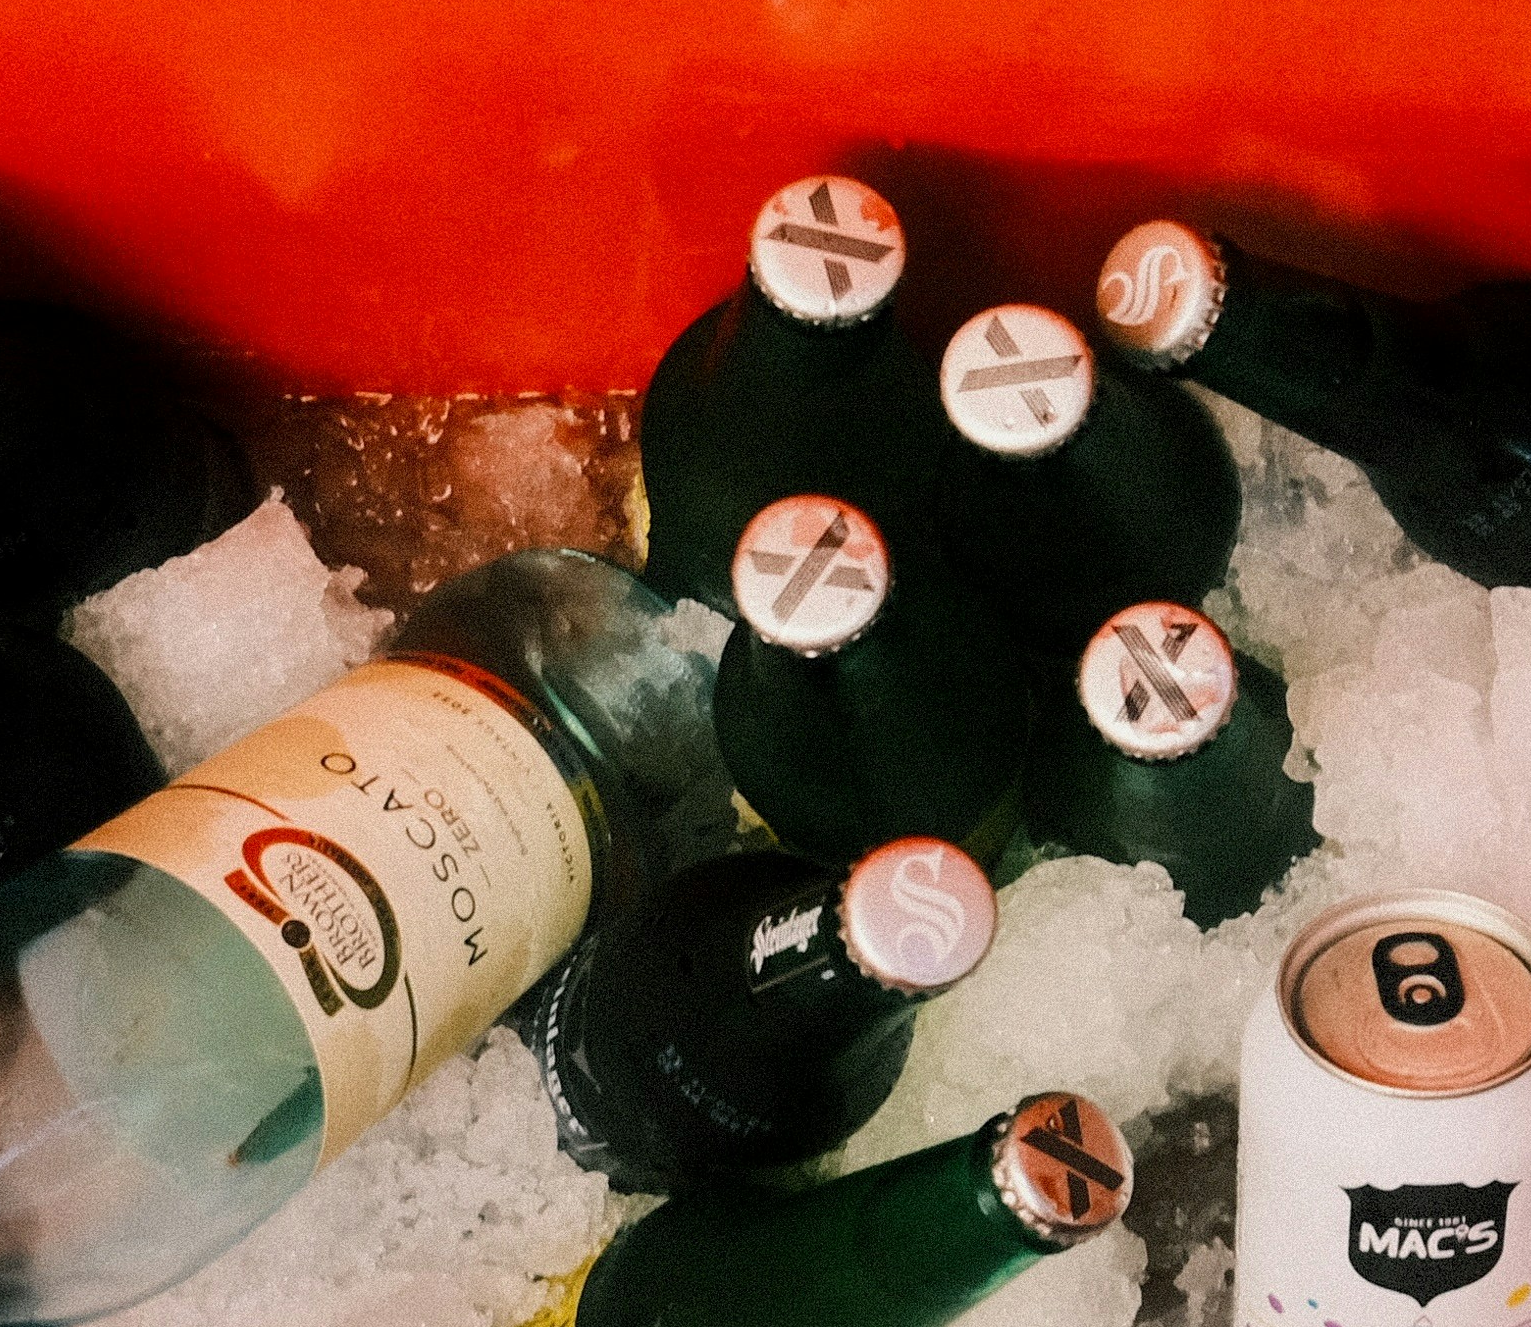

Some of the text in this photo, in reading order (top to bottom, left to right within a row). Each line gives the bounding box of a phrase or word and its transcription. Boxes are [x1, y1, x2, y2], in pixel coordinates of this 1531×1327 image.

[320, 752, 487, 967] MOSCATO
[423, 788, 482, 857] ZERO
[278, 874, 355, 966] BROWN
[281, 851, 377, 970] BROTHERS
[1358, 1219, 1499, 1259] MAC'S
